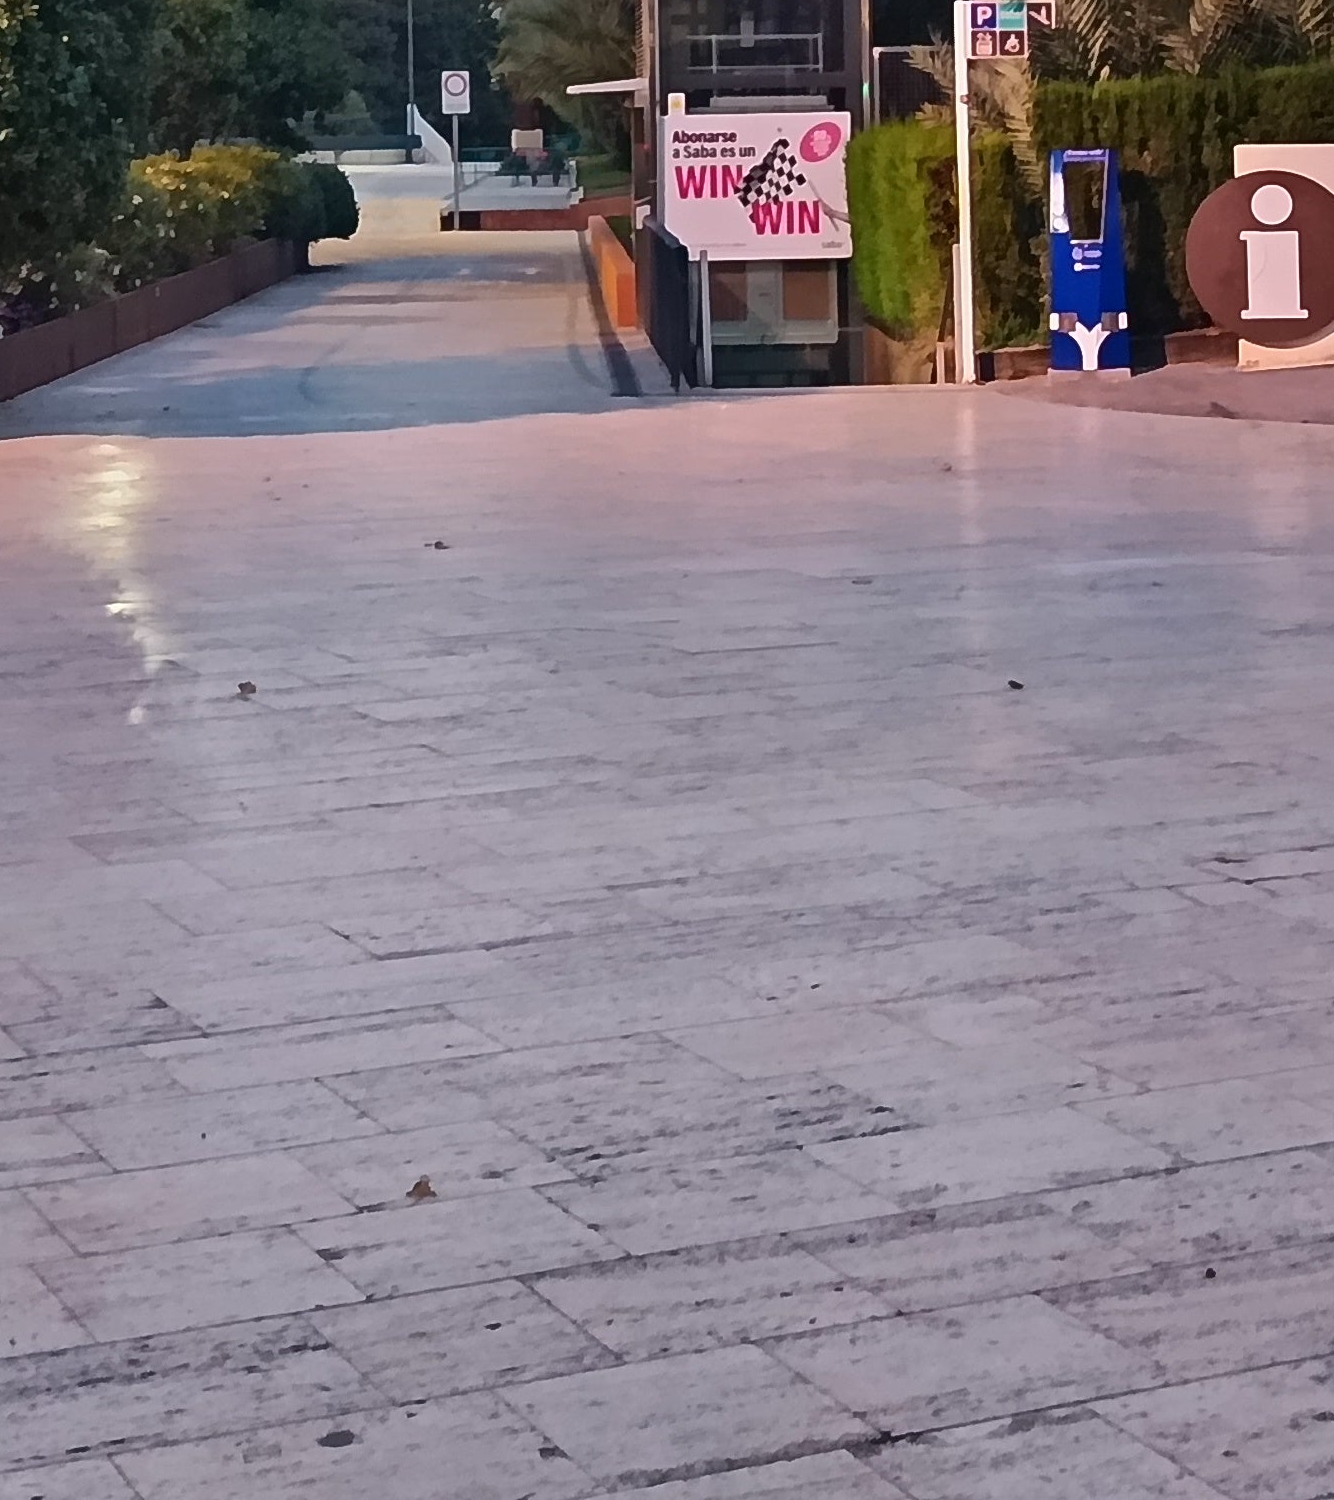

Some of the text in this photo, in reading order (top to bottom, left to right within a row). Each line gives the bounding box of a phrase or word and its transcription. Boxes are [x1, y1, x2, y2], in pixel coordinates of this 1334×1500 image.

[672, 130, 738, 144] Abonarse
[672, 145, 756, 158] a Saba es un
[674, 165, 743, 199] WIN
[751, 200, 820, 235] WIN
